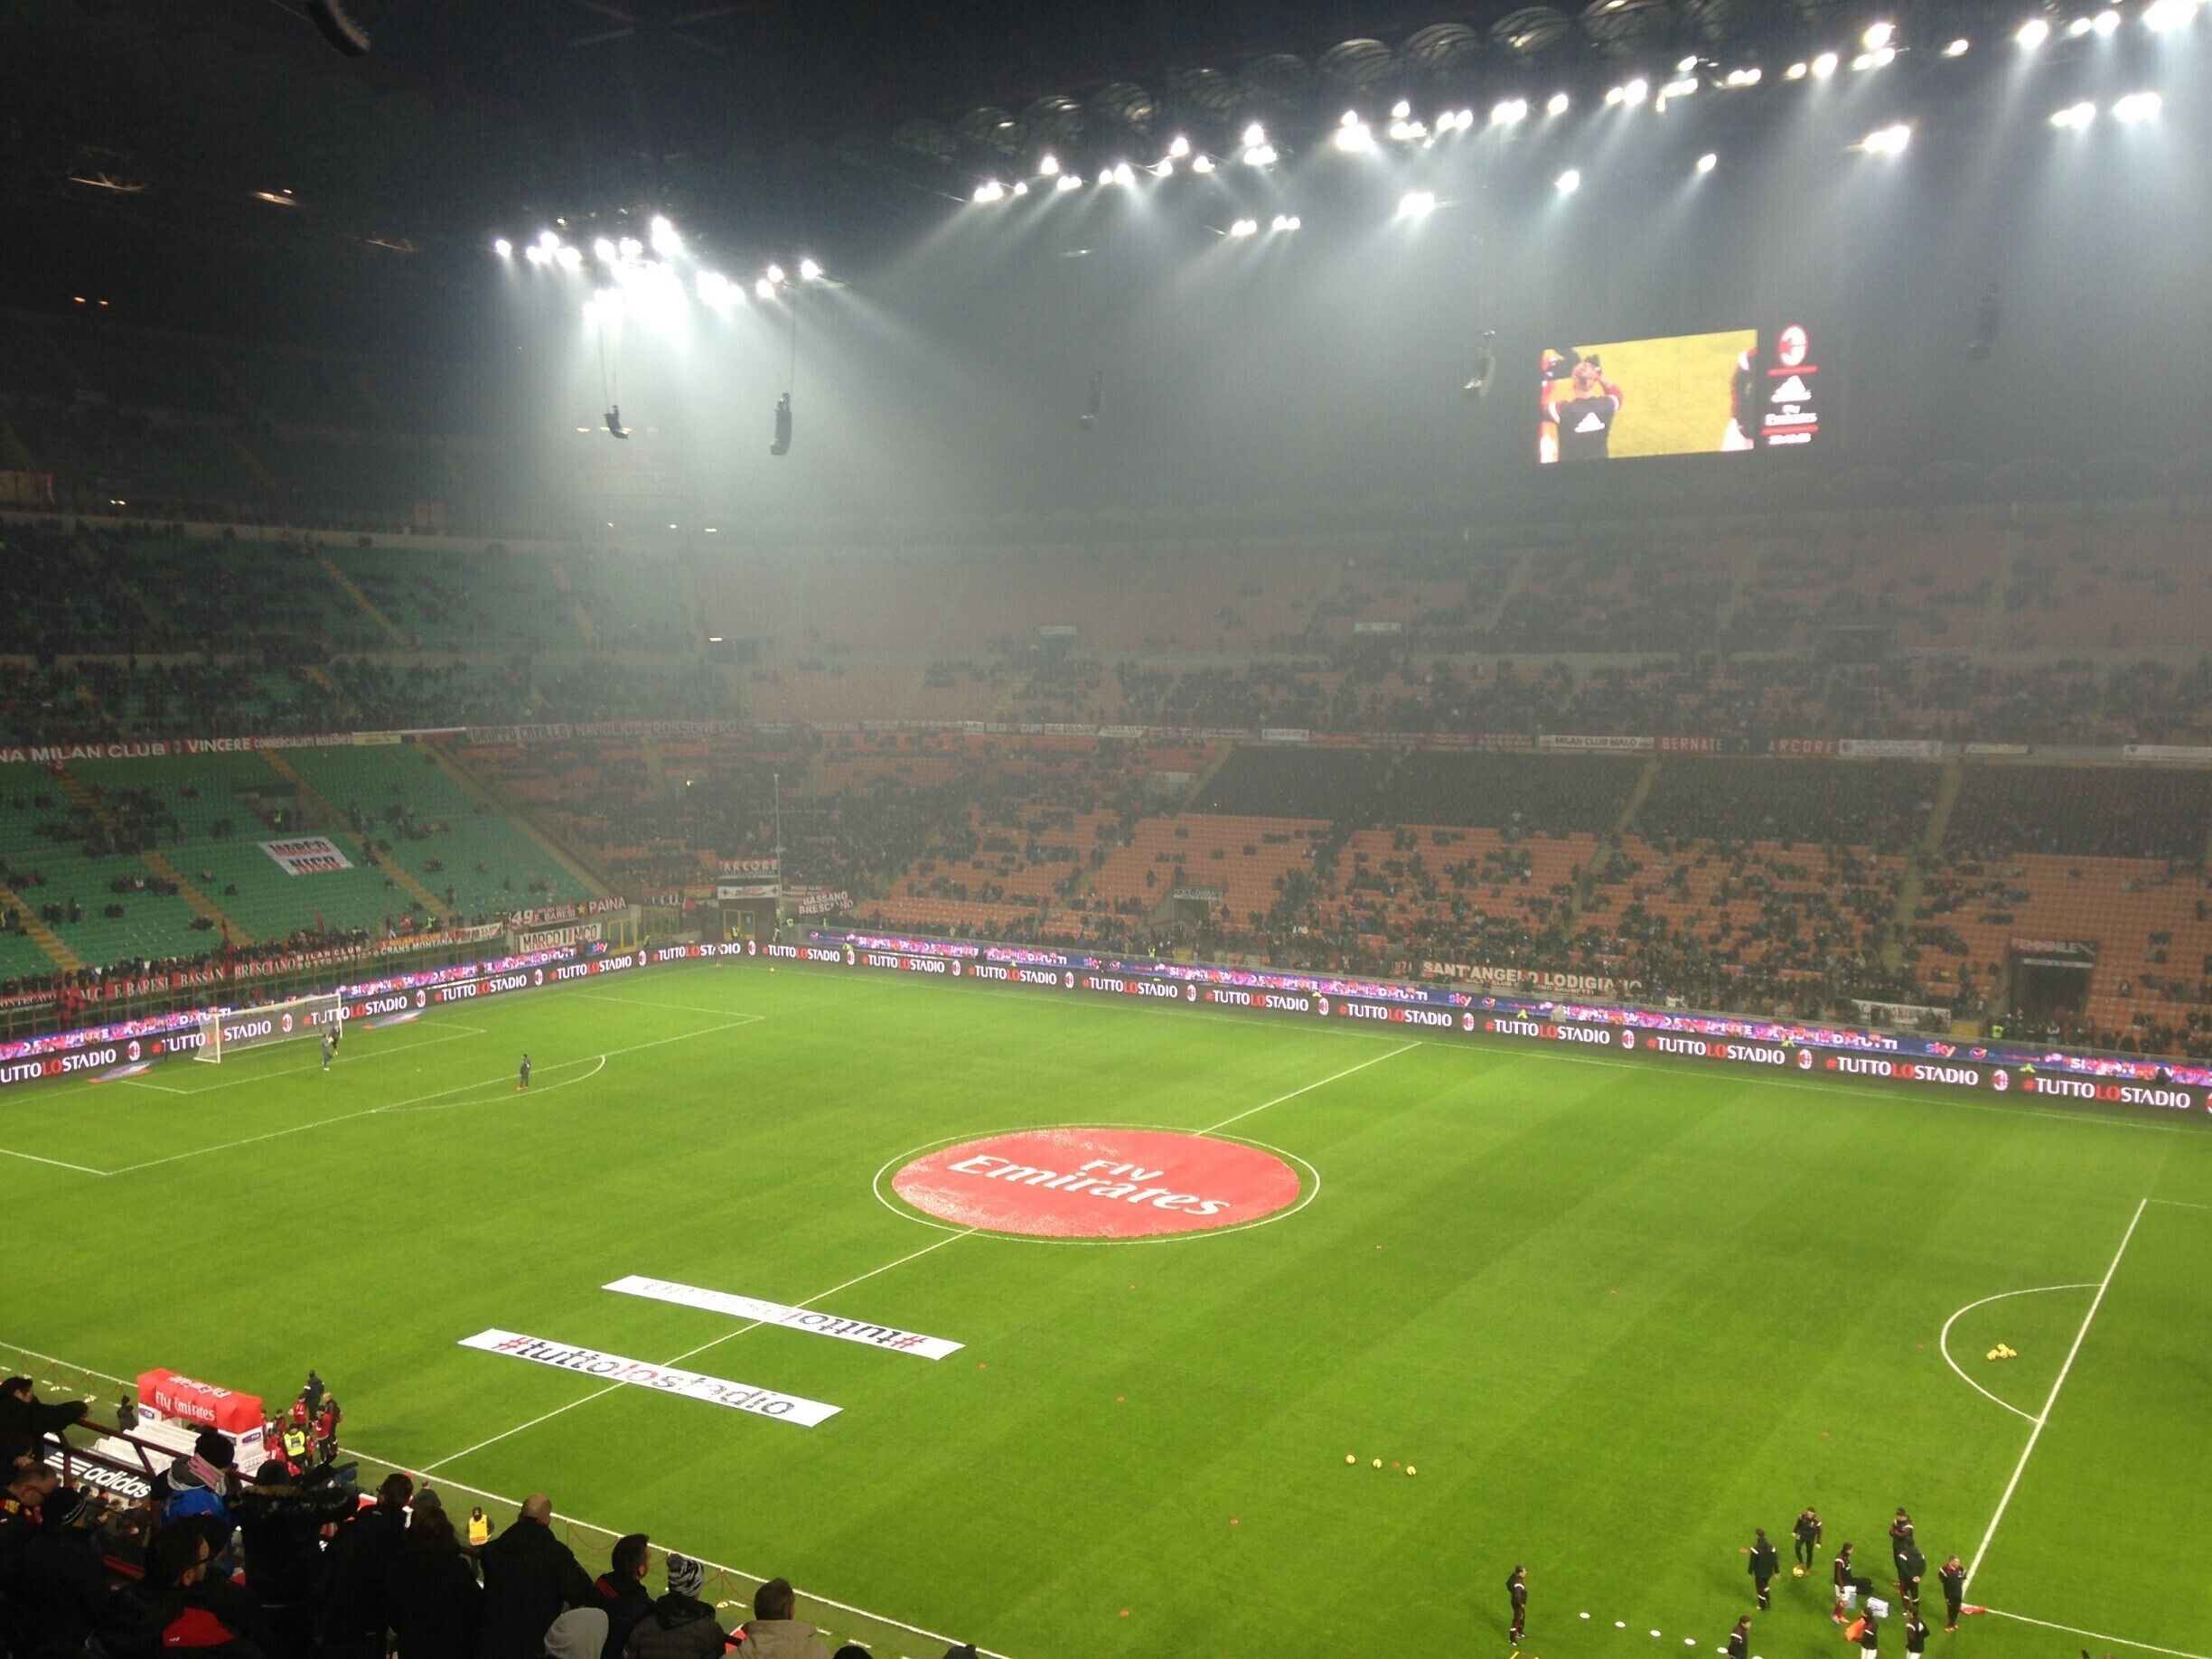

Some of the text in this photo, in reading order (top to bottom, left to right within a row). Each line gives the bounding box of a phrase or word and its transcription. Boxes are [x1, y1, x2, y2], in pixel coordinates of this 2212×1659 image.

[31, 744, 101, 762] MILAN
[108, 743, 166, 758] CLUB
[187, 736, 251, 754] VINCERE
[589, 896, 627, 914] PAINA
[523, 931, 561, 950] MARCO
[1448, 992, 1472, 1007] sky
[1080, 1158, 1166, 1183] Fly
[947, 1154, 1231, 1215] Emirates
[155, 1390, 216, 1421] Fly Emirates
[83, 1467, 152, 1498] adidas
